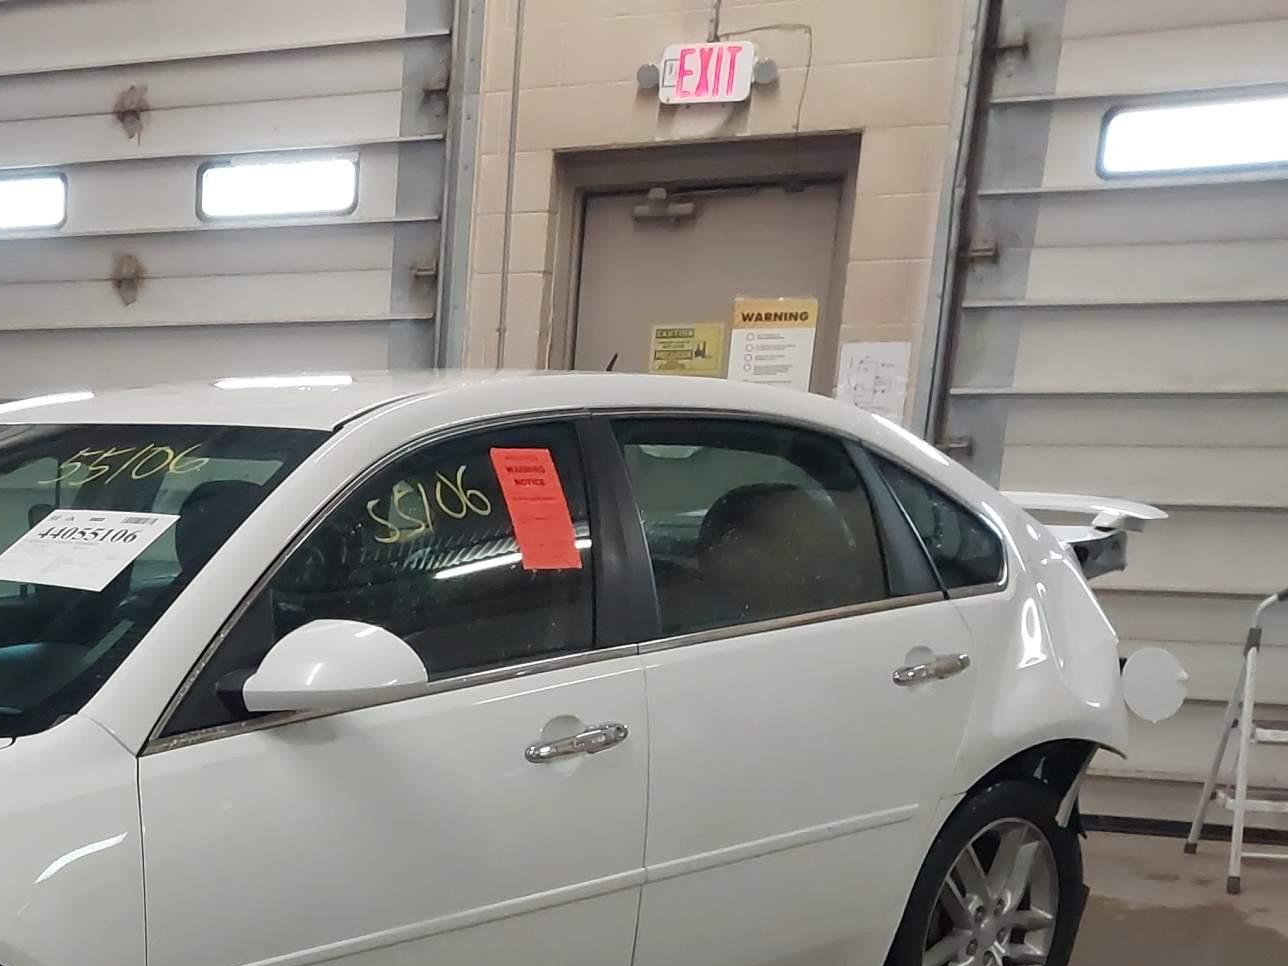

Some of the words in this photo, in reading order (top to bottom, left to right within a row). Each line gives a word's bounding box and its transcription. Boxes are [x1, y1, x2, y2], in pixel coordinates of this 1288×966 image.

[676, 46, 743, 97] EXIT
[740, 311, 809, 322] WARNING
[37, 443, 210, 486] 55106
[38, 526, 144, 544] 44055106
